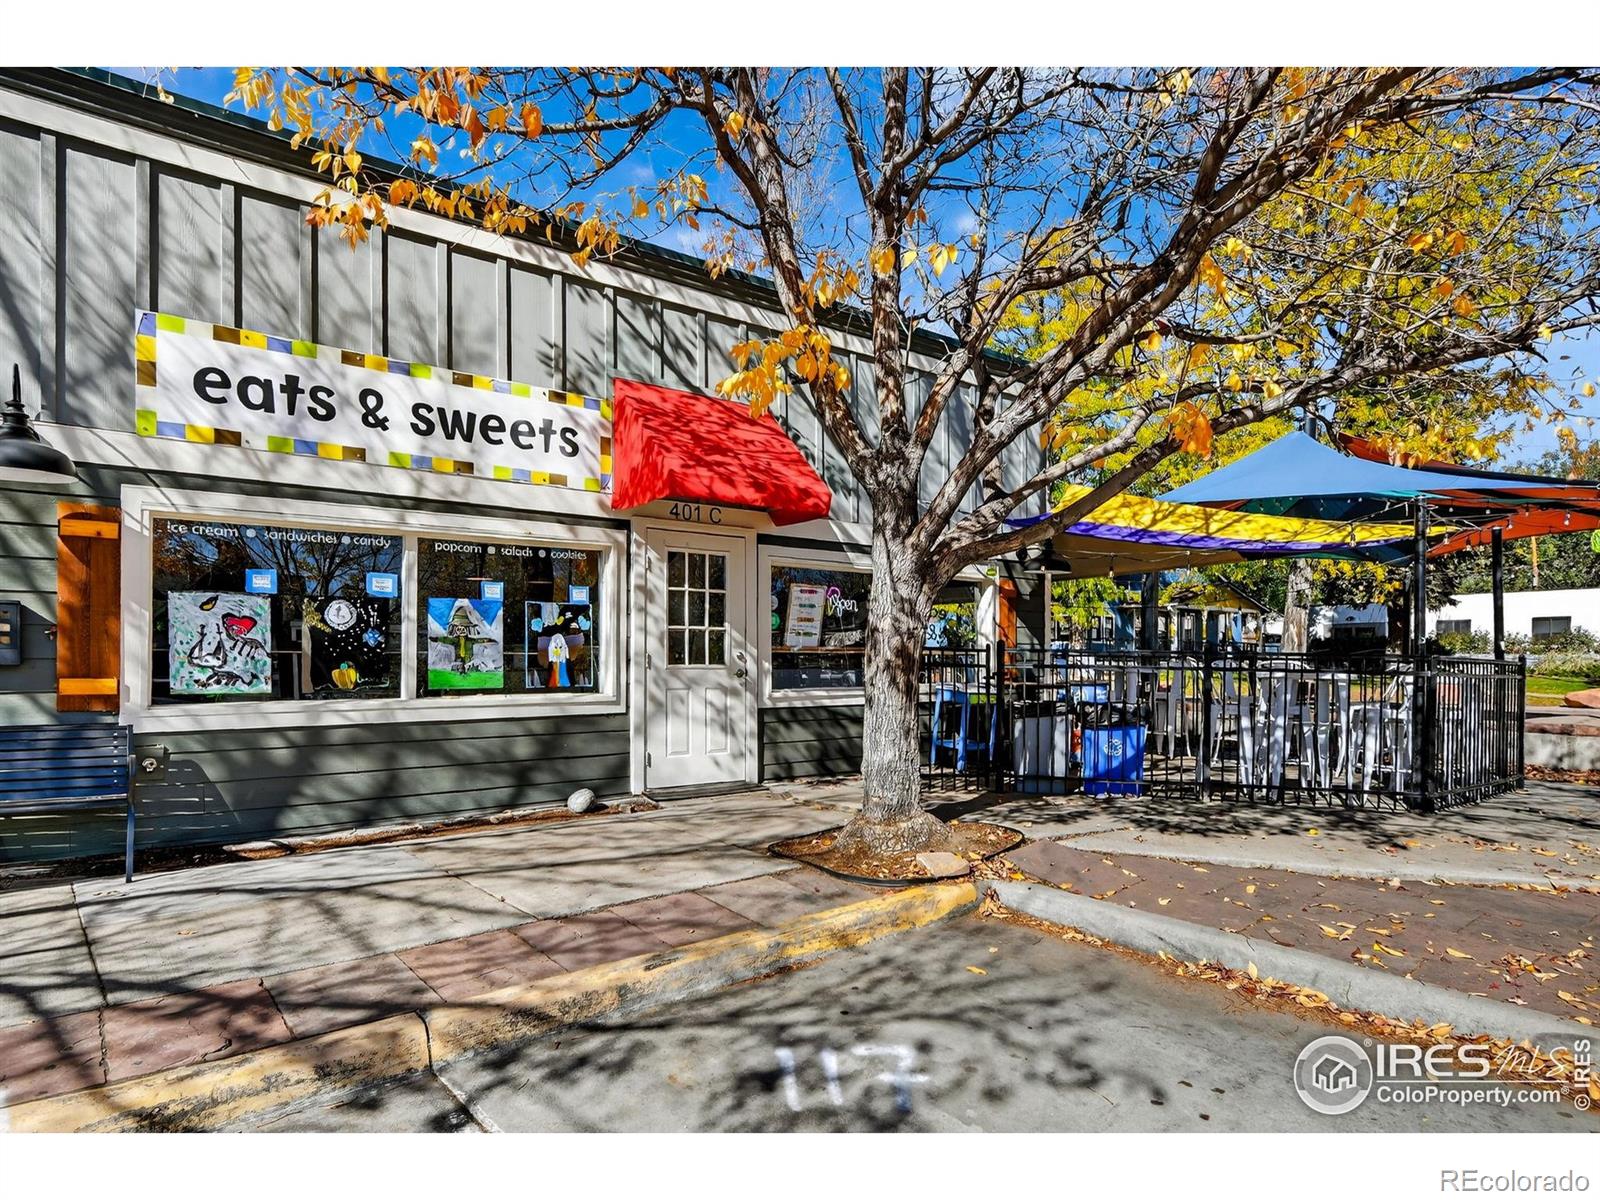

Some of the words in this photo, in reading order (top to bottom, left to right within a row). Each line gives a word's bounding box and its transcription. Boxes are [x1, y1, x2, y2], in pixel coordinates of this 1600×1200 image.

[193, 366, 336, 422] eats
[360, 388, 390, 431] &
[410, 402, 580, 458] sweets
[669, 503, 700, 521] 401
[709, 507, 722, 524] C
[192, 525, 239, 538] cream
[353, 536, 391, 549] candy
[501, 546, 533, 557] salads
[550, 550, 587, 560] cookies
